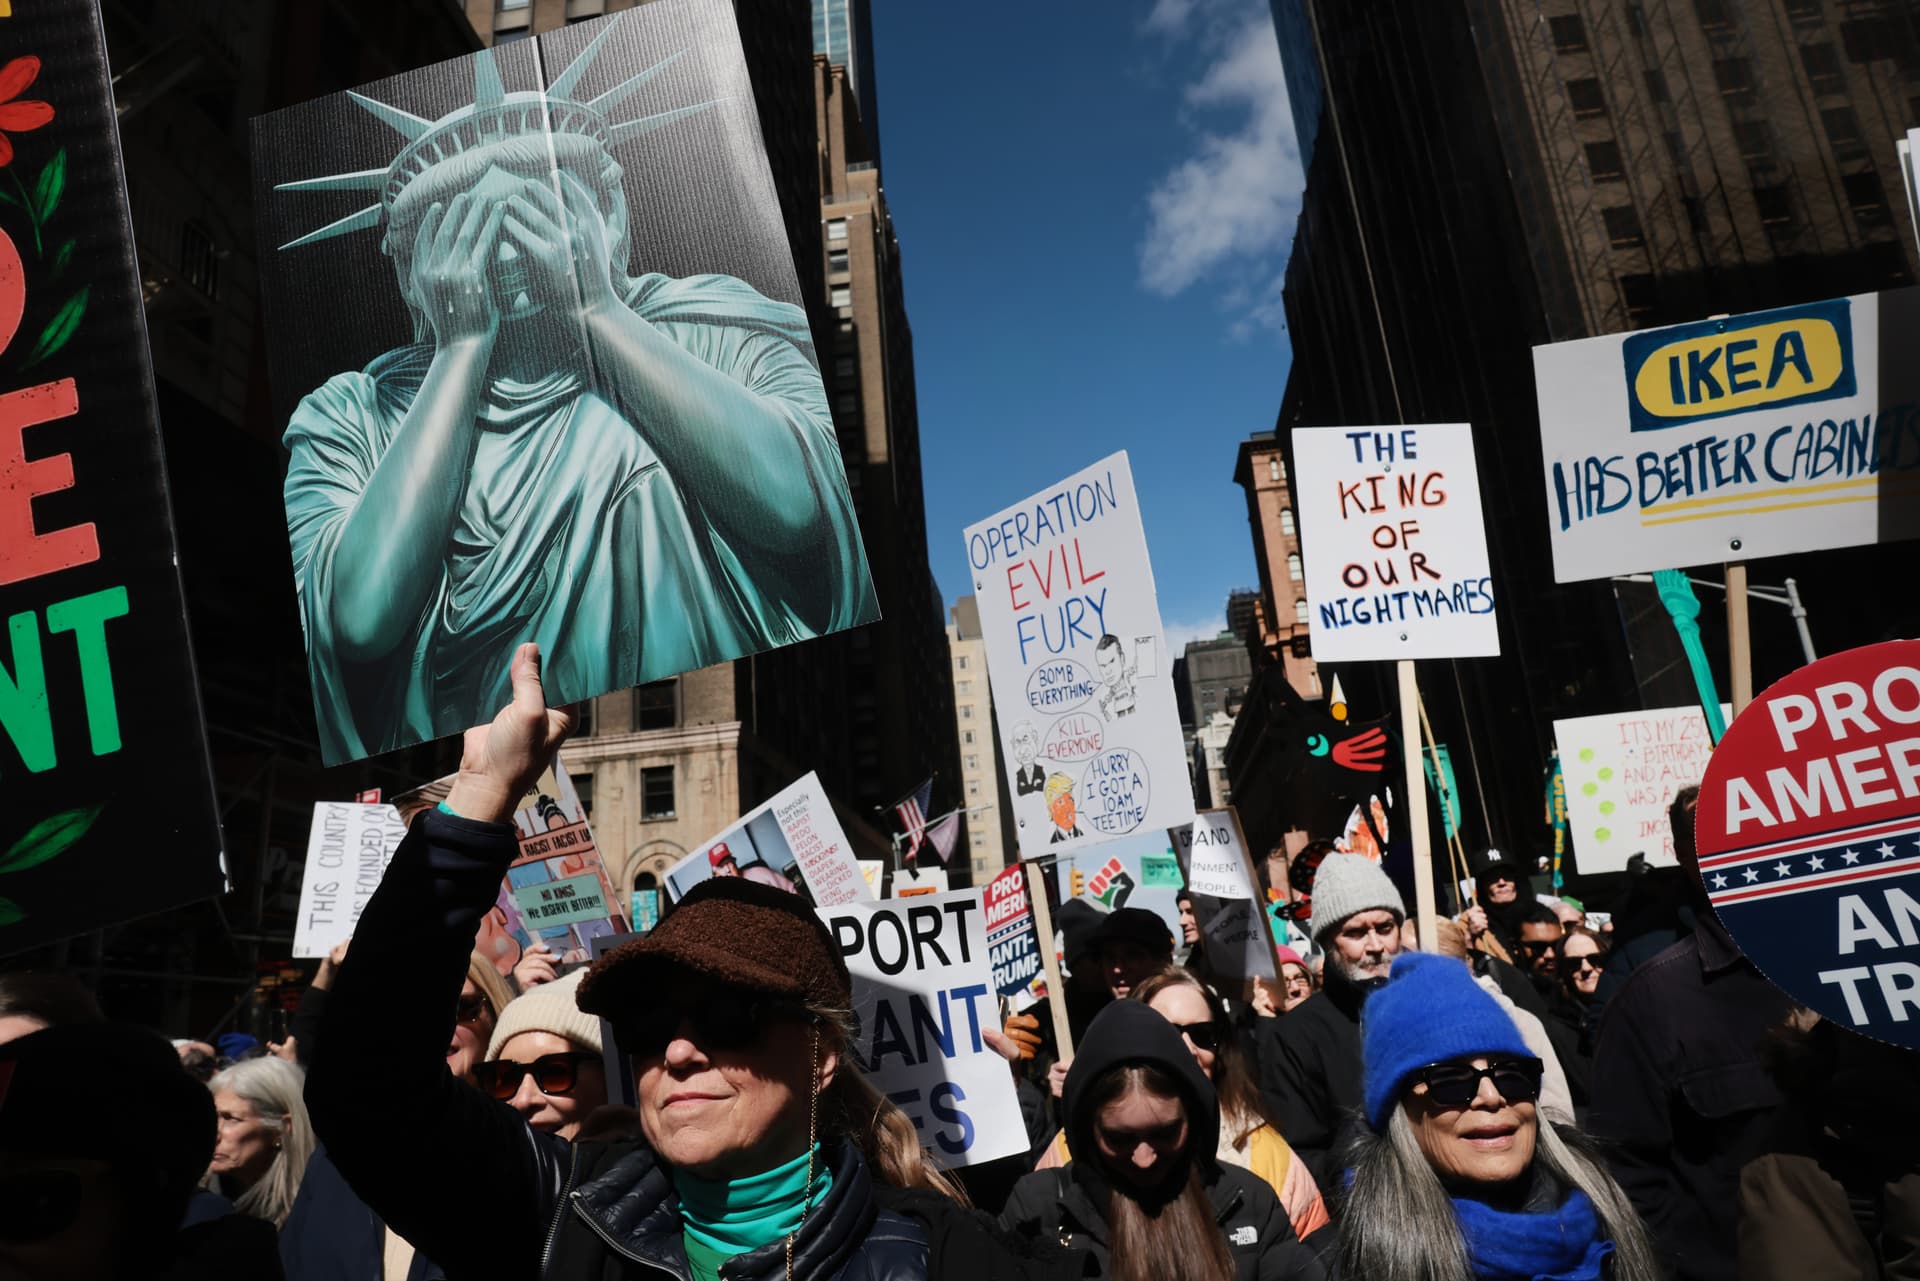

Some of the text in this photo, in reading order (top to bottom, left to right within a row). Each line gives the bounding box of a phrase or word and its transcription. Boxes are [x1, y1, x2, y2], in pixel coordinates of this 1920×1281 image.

[1668, 329, 1814, 405] IKEA
[1345, 430, 1417, 463] THE
[1337, 471, 1448, 521] KING
[1552, 455, 1632, 531] HAS
[1636, 432, 1758, 508] BETTER
[970, 471, 1117, 570] OPERATION
[1371, 519, 1420, 551] OF
[1007, 538, 1105, 611] EVIL
[1341, 551, 1442, 589] OUR
[1319, 577, 1495, 630] NIGHTMARES
[1016, 587, 1107, 665] FURY
[1039, 664, 1074, 688] BOMB
[1030, 680, 1096, 707] EVERYTHING
[1766, 666, 1920, 753] PRO
[1058, 717, 1090, 737] KILL
[1046, 733, 1102, 760] EVERYONE
[1091, 751, 1130, 780] HURRY
[1623, 766, 1656, 784] AND
[1660, 764, 1691, 781] ALL
[1086, 772, 1143, 800] I GOT A
[1626, 787, 1657, 806] WAS
[777, 793, 809, 818] Especially
[781, 812, 795, 826] not
[1092, 806, 1144, 831] TEE TIME
[523, 838, 551, 858] RACIST
[1195, 827, 1231, 848] AND
[308, 803, 350, 930] THIS COUNTRY
[355, 827, 384, 895] FOUNDED
[814, 861, 849, 887] WEARING
[540, 884, 576, 901] NO KINGS
[991, 870, 1023, 902] PRO
[542, 901, 570, 918] DESERVE
[829, 898, 977, 977] PORT
[991, 933, 1034, 969] ANTI-
[992, 952, 1041, 990] RUMP
[1817, 961, 1920, 1026] TR
